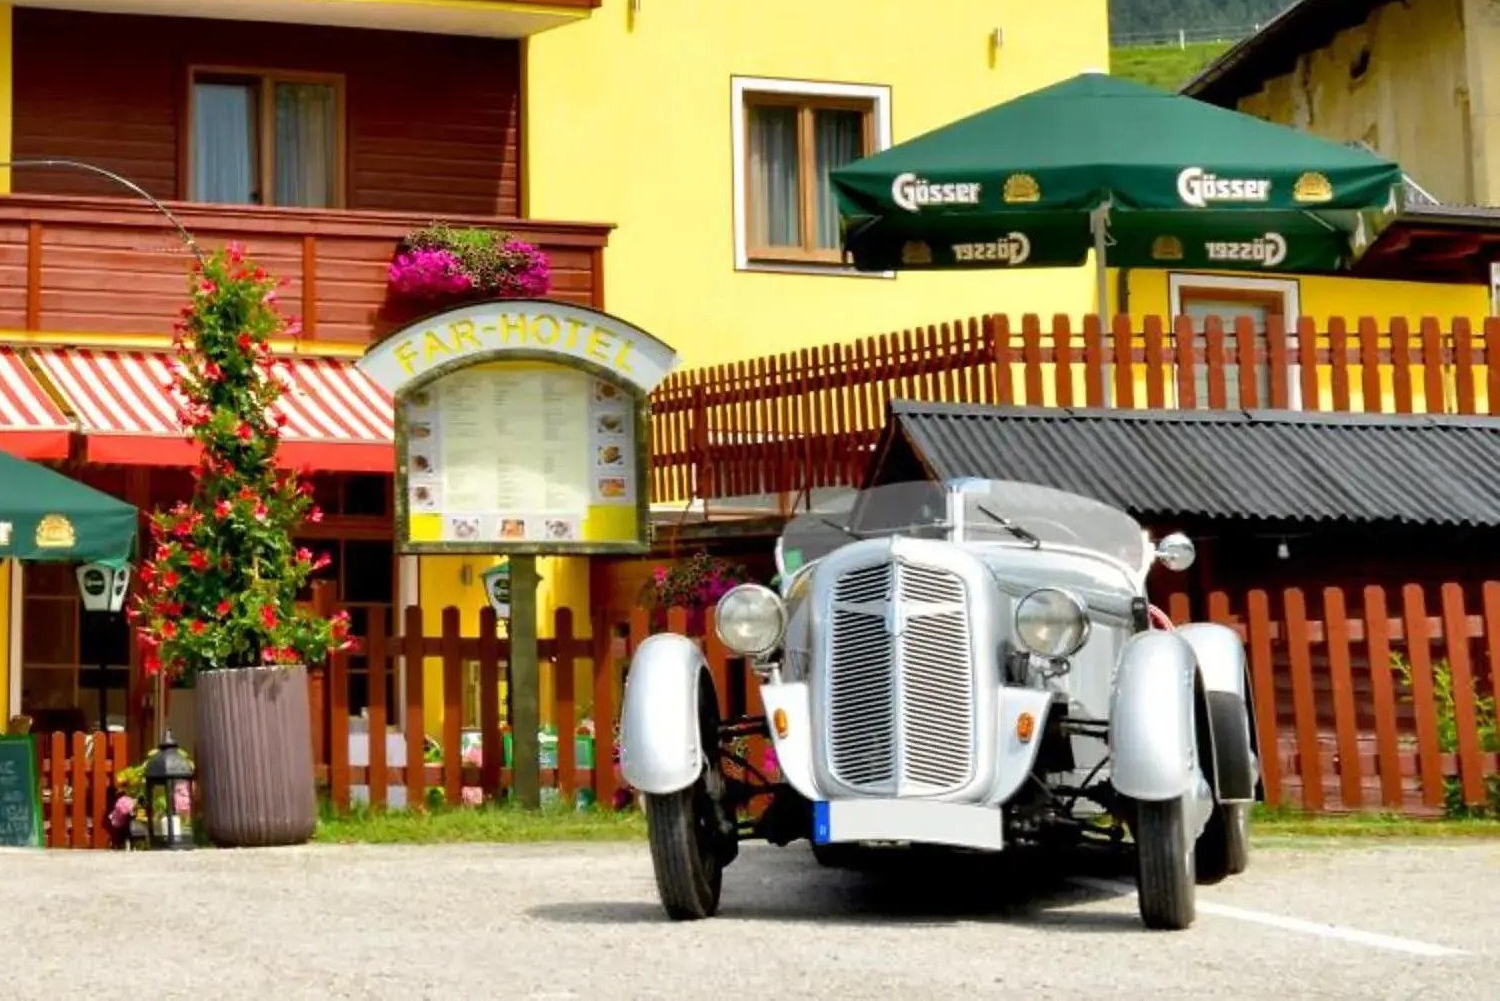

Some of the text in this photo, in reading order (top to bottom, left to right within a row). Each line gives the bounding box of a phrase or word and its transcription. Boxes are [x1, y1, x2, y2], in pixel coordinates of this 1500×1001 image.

[891, 172, 982, 213] Gösser
[1177, 166, 1271, 207] Gösser
[391, 311, 638, 375] FAR-HOTEL
